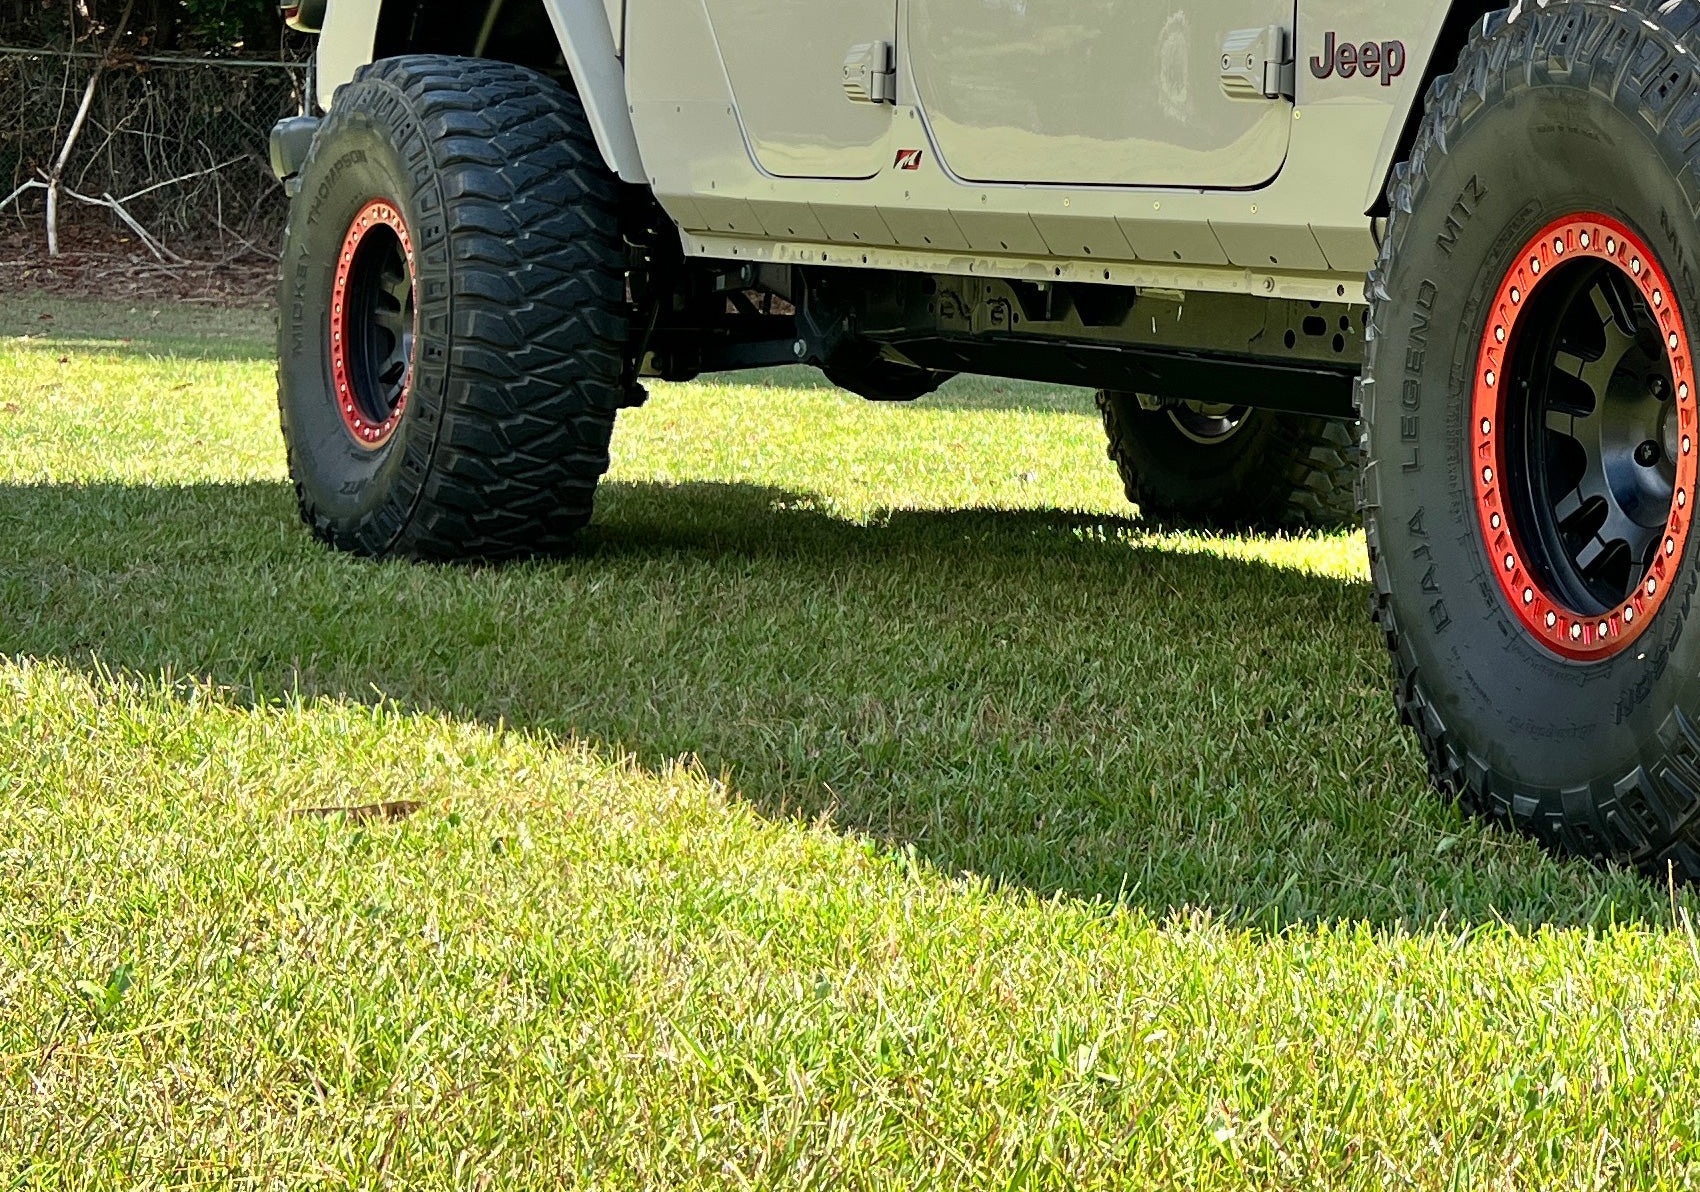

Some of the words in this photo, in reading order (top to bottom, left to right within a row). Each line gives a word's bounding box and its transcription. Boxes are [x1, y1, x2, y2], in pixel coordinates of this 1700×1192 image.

[1309, 31, 1406, 86] Jeep
[306, 149, 369, 226] THOMPSON
[1435, 171, 1490, 259] MTZ
[1400, 278, 1438, 474] LEGEND
[1407, 505, 1452, 635] BAJA
